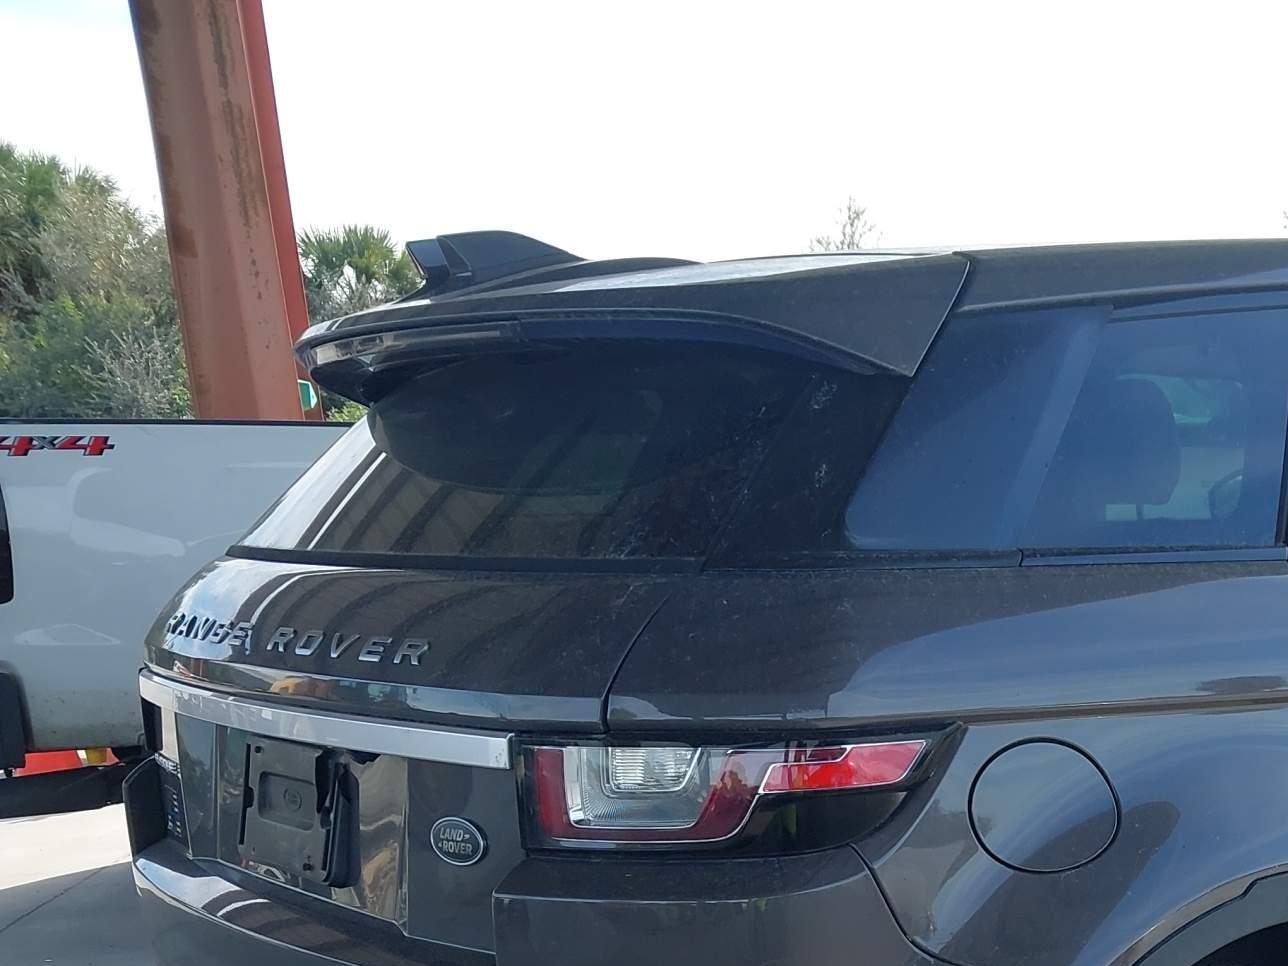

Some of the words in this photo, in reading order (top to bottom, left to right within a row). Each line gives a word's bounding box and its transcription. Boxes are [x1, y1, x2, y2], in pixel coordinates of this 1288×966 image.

[164, 612, 252, 647] RANGE
[266, 626, 431, 666] ROVER
[443, 840, 473, 855] ROVER
